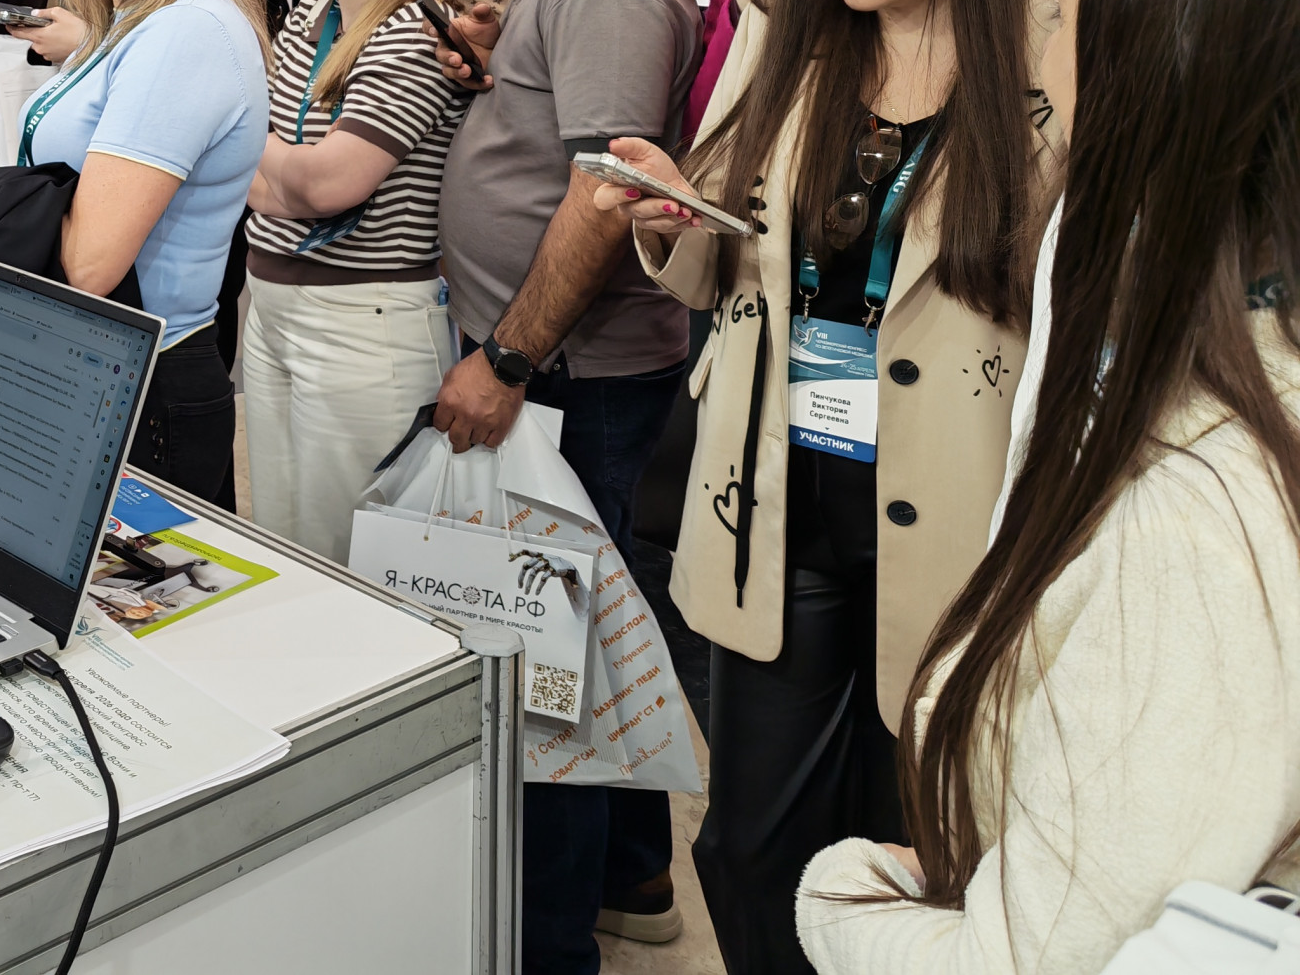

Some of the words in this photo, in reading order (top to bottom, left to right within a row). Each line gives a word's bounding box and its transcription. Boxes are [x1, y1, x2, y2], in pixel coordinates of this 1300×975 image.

[26, 107, 45, 135] ABG
[810, 391, 851, 406] Пинчукова
[811, 401, 848, 415] Виктория
[809, 410, 850, 425] Сергеевна
[799, 430, 855, 453] УЧАСТНИК
[446, 607, 478, 620] ПАРТНЕР
[485, 616, 505, 626] МИРЕ
[600, 612, 648, 650] Ниаспам
[612, 639, 653, 671] Рубролекс
[85, 667, 129, 699] Уважаемые
[129, 698, 171, 727] партнеры!
[22, 704, 35, 717] что
[33, 713, 58, 734] время
[34, 678, 45, 687] по
[91, 720, 131, 751] медицине.
[67, 675, 95, 695] апреля
[95, 694, 113, 708] 2026
[112, 707, 132, 722] года
[131, 720, 173, 751] состоится
[1, 700, 27, 724] нашего
[26, 722, 75, 762] мероприятия
[73, 761, 99, 780] будет
[24, 688, 74, 731] предстоящей
[106, 754, 130, 773] Вами
[130, 770, 138, 779] и
[111, 720, 148, 747] конгресс
[42, 752, 102, 798] продуктивным!
